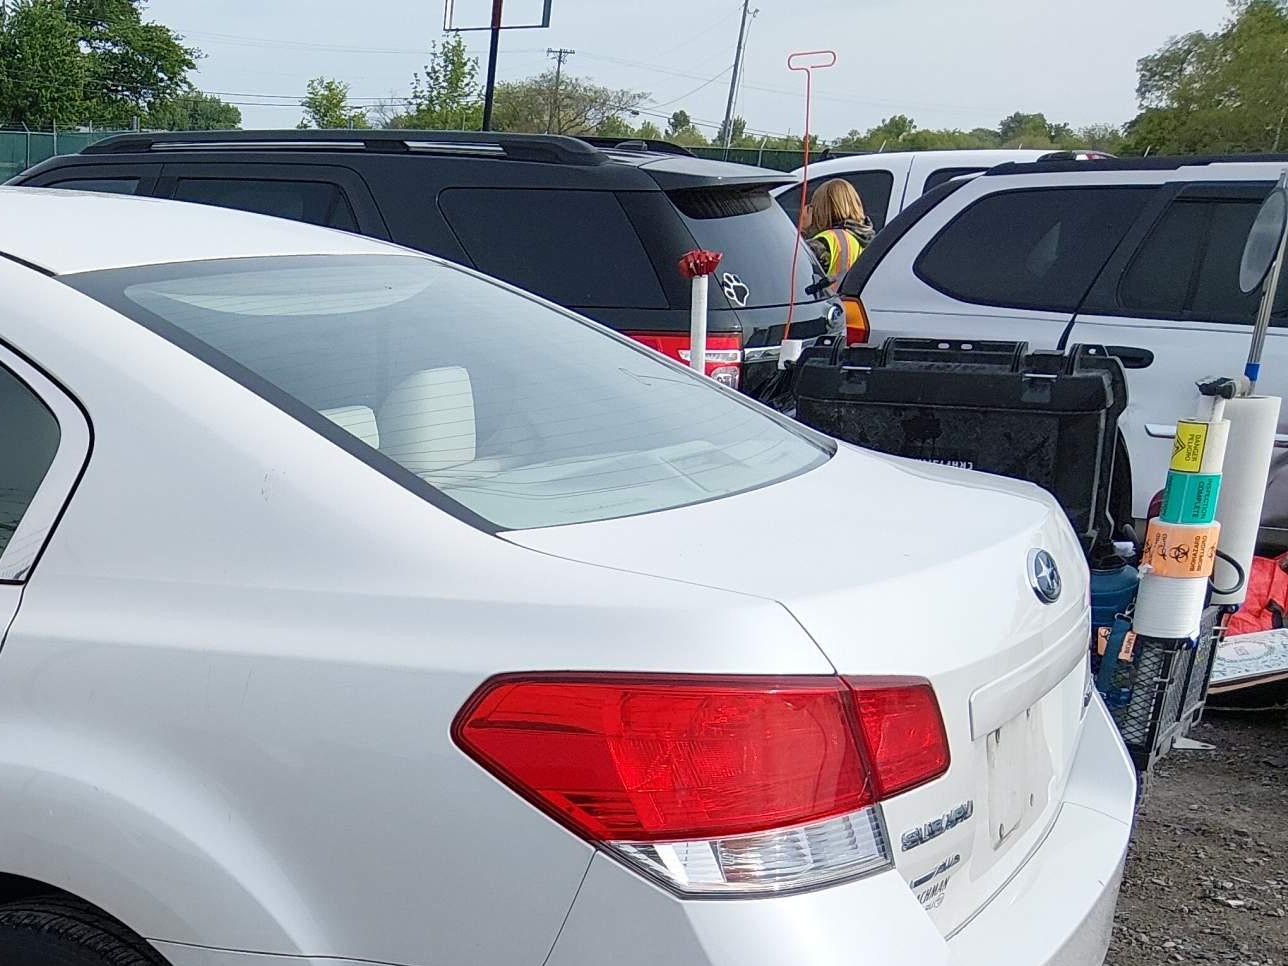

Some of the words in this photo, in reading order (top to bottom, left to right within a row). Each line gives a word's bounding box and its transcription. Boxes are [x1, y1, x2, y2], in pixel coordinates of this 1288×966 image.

[1184, 433, 1195, 462] PELIGRO
[1191, 434, 1202, 462] DANGER
[1189, 535, 1201, 572] BIOHAZARD
